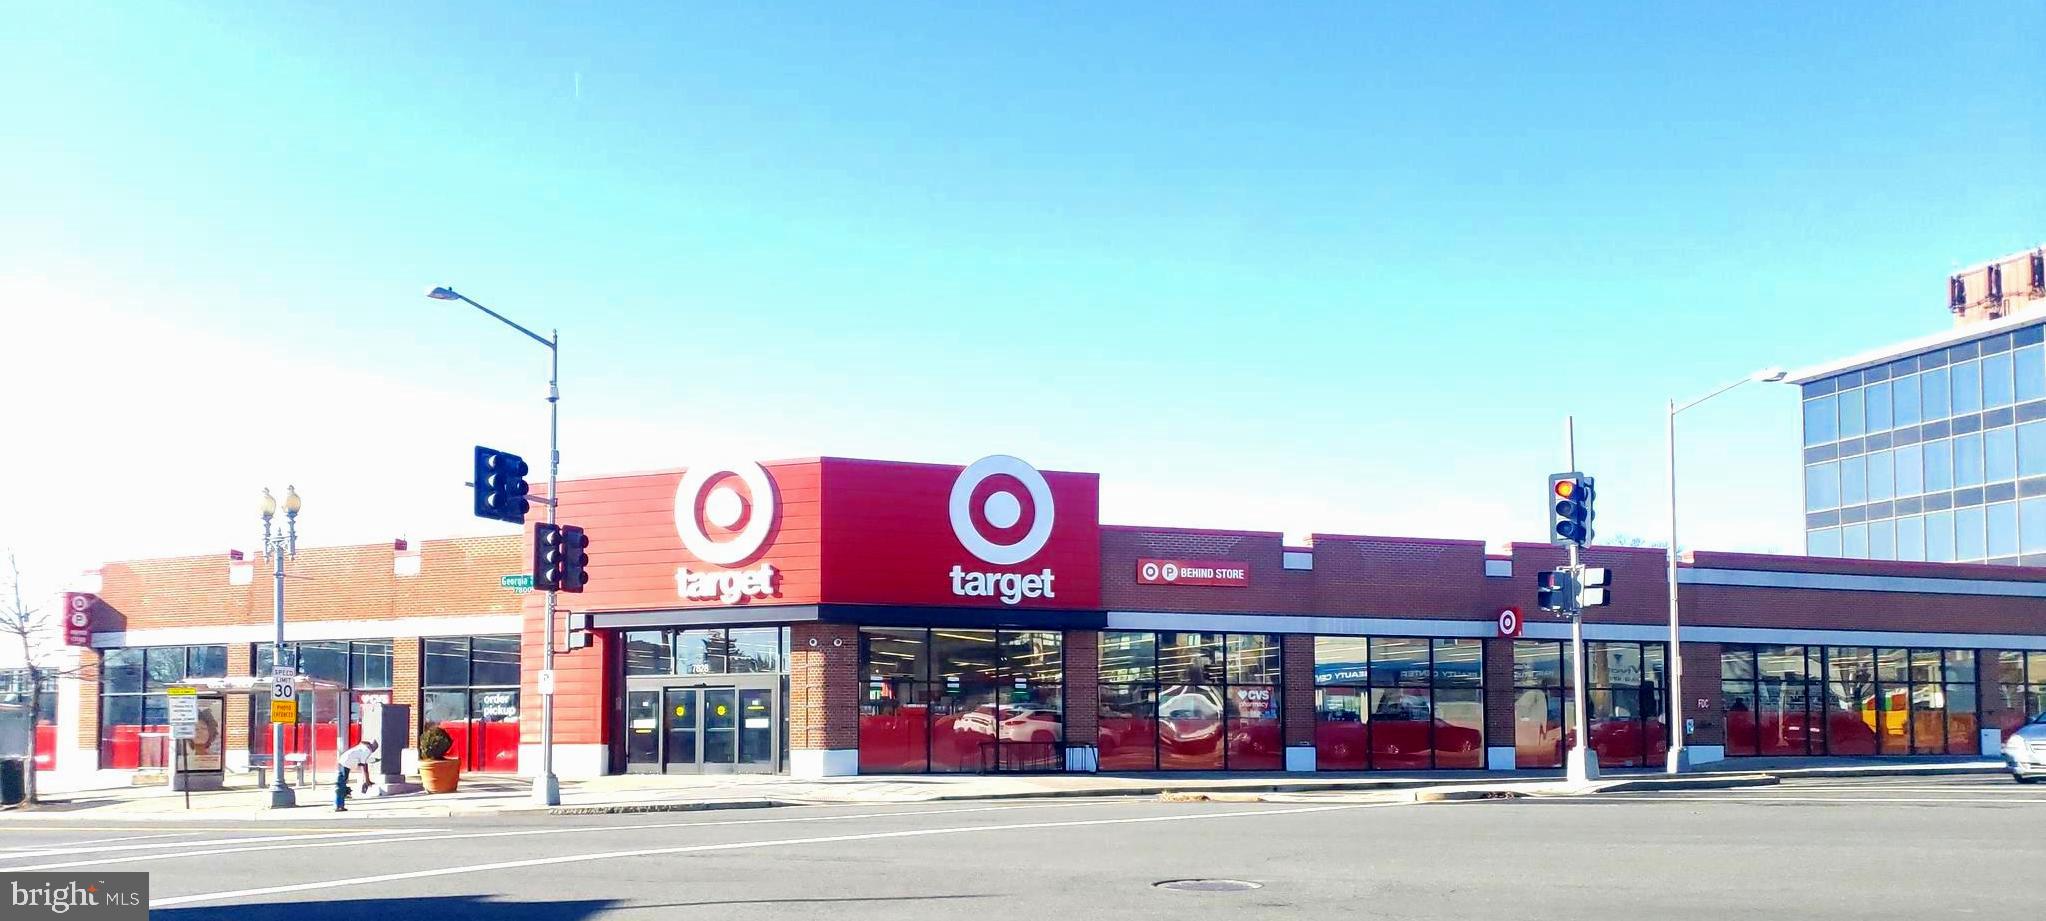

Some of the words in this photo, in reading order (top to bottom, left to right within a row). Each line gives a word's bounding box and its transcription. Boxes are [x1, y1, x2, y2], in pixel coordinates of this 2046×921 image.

[1180, 567, 1214, 578] BEHIND
[1215, 568, 1244, 580] STORE
[501, 576, 528, 587] Georgia
[675, 563, 775, 604] target
[949, 565, 1055, 605] target
[274, 684, 292, 698] 30
[1248, 690, 1269, 700] CVS
[483, 693, 510, 704] order
[1239, 700, 1269, 709] pharmacy
[483, 704, 517, 717] pickup
